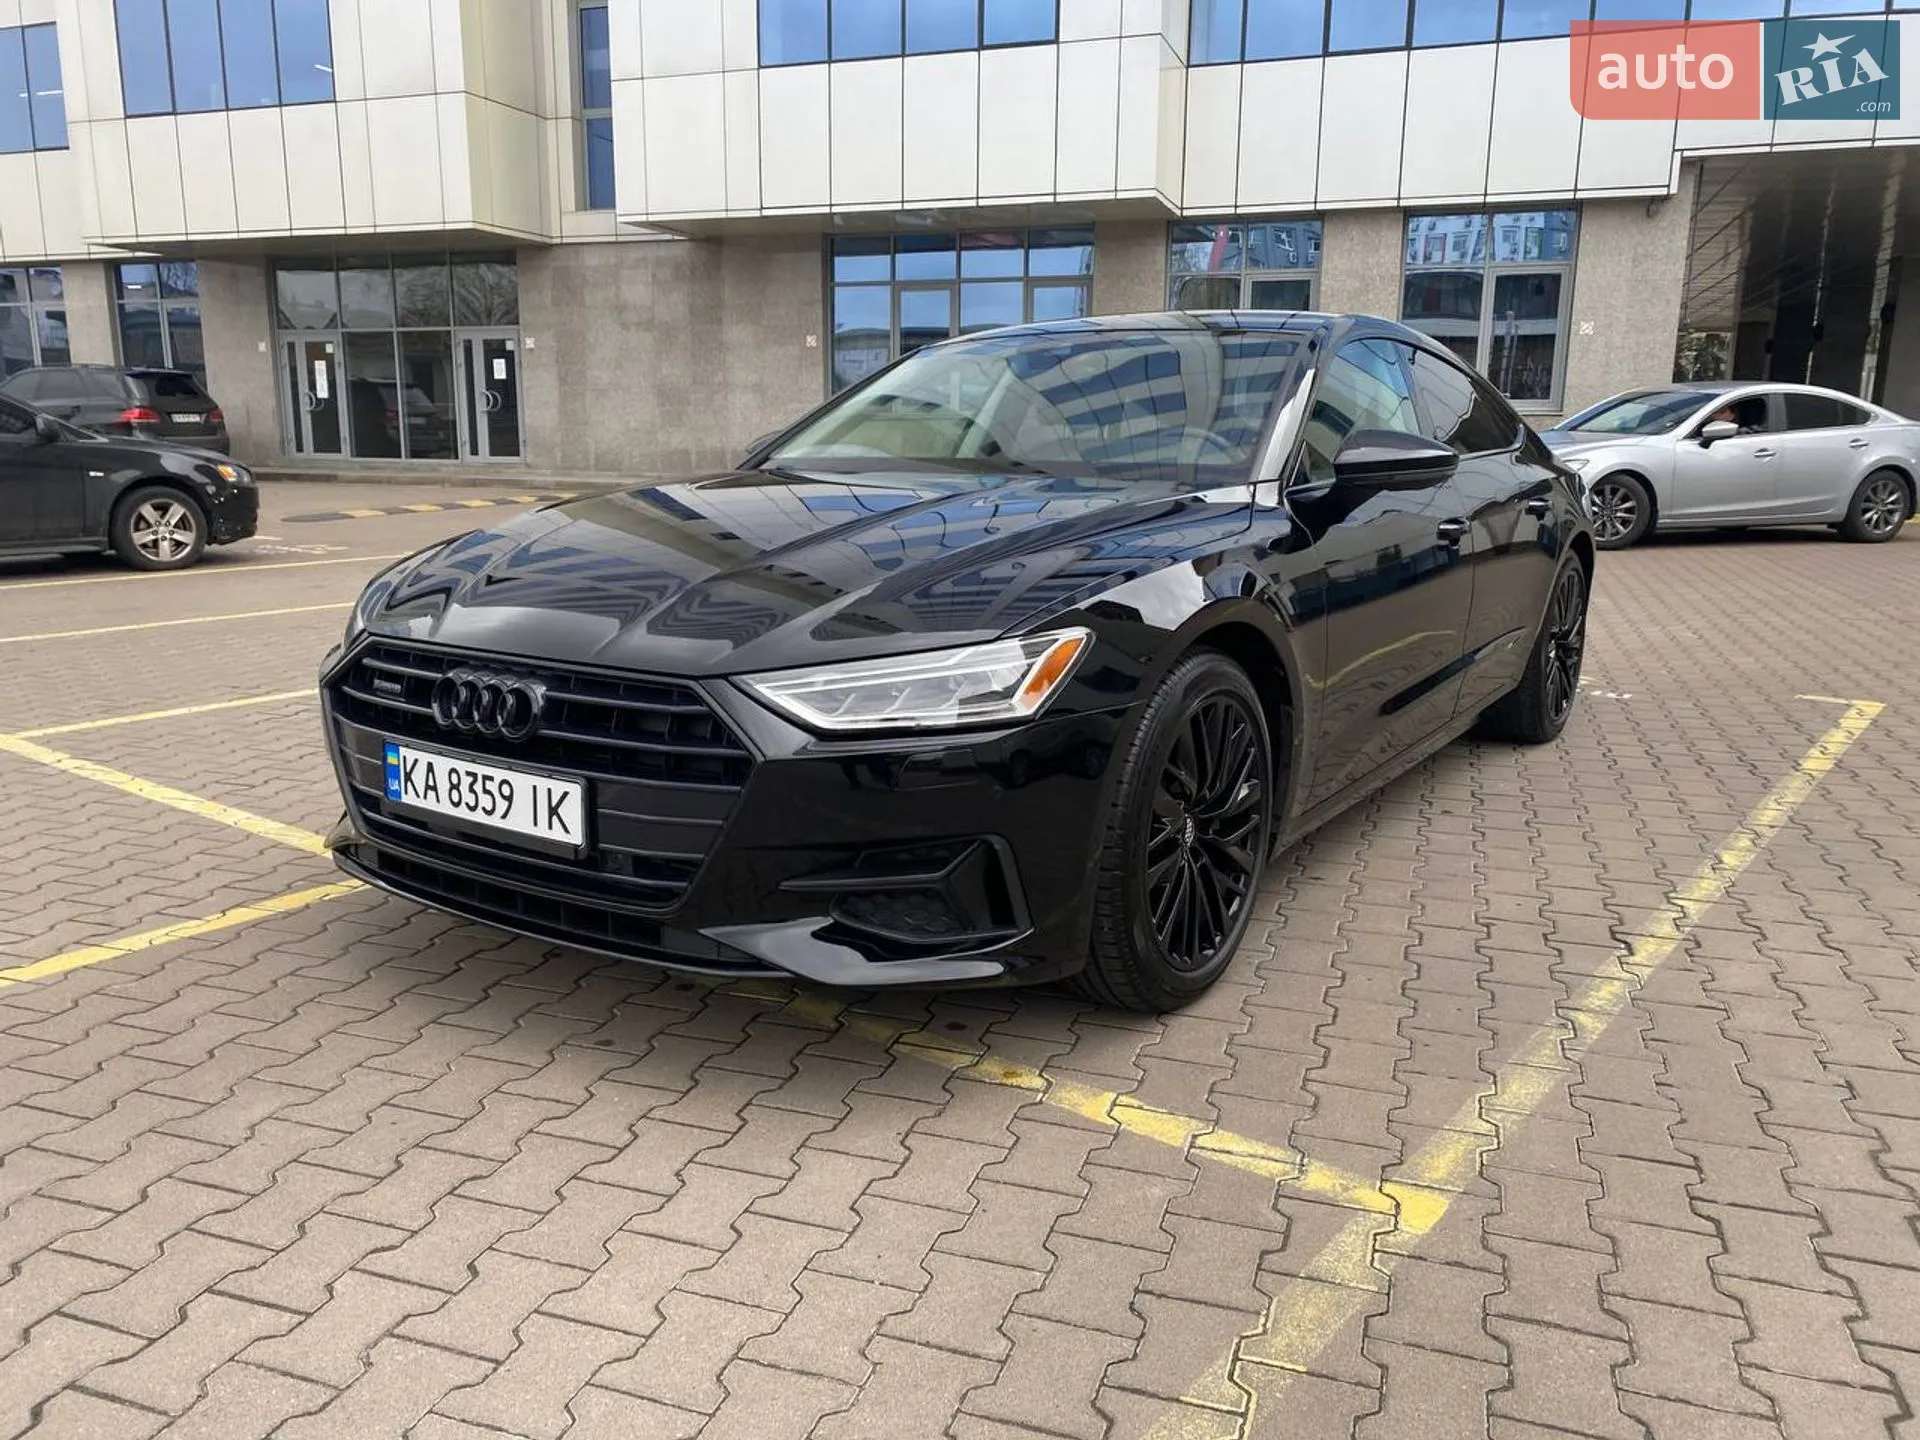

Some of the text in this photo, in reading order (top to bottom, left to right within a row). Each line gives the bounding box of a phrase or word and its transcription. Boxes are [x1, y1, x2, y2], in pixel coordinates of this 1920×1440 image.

[402, 755, 570, 834] KA 8359 IK
